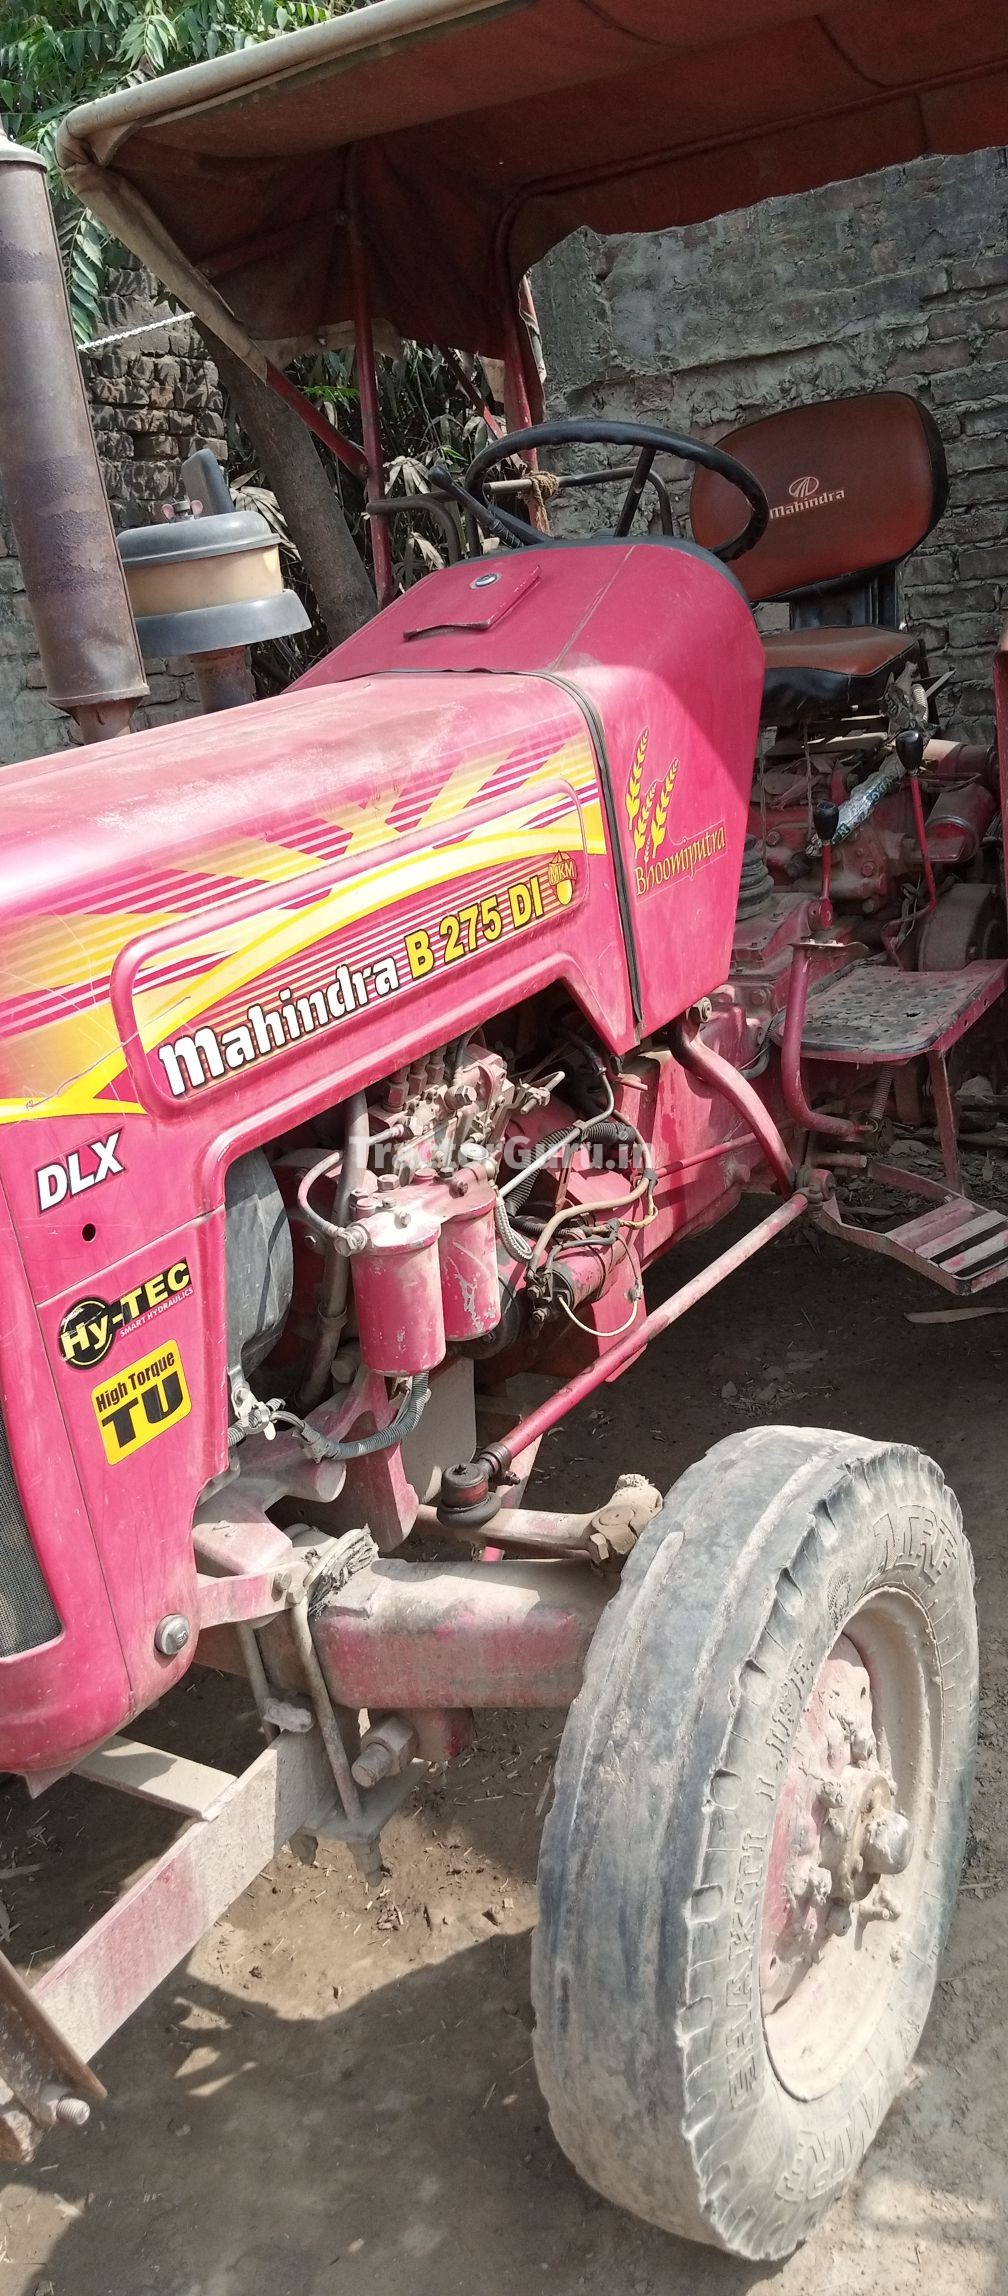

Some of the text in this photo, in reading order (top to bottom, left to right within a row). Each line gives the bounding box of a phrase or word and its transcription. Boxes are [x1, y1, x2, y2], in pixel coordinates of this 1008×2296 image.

[769, 489, 845, 519] Mahindra
[549, 861, 576, 884] MKM
[634, 826, 726, 896] Bhoomiputra
[158, 875, 545, 1097] Mahindra B 275 DI
[38, 1131, 126, 1212] DLX
[60, 1262, 190, 1361] Hy-TEC
[120, 1287, 194, 1338] SMART HYDRAULICS
[96, 1352, 175, 1413] High Torque
[101, 1370, 183, 1449] TU
